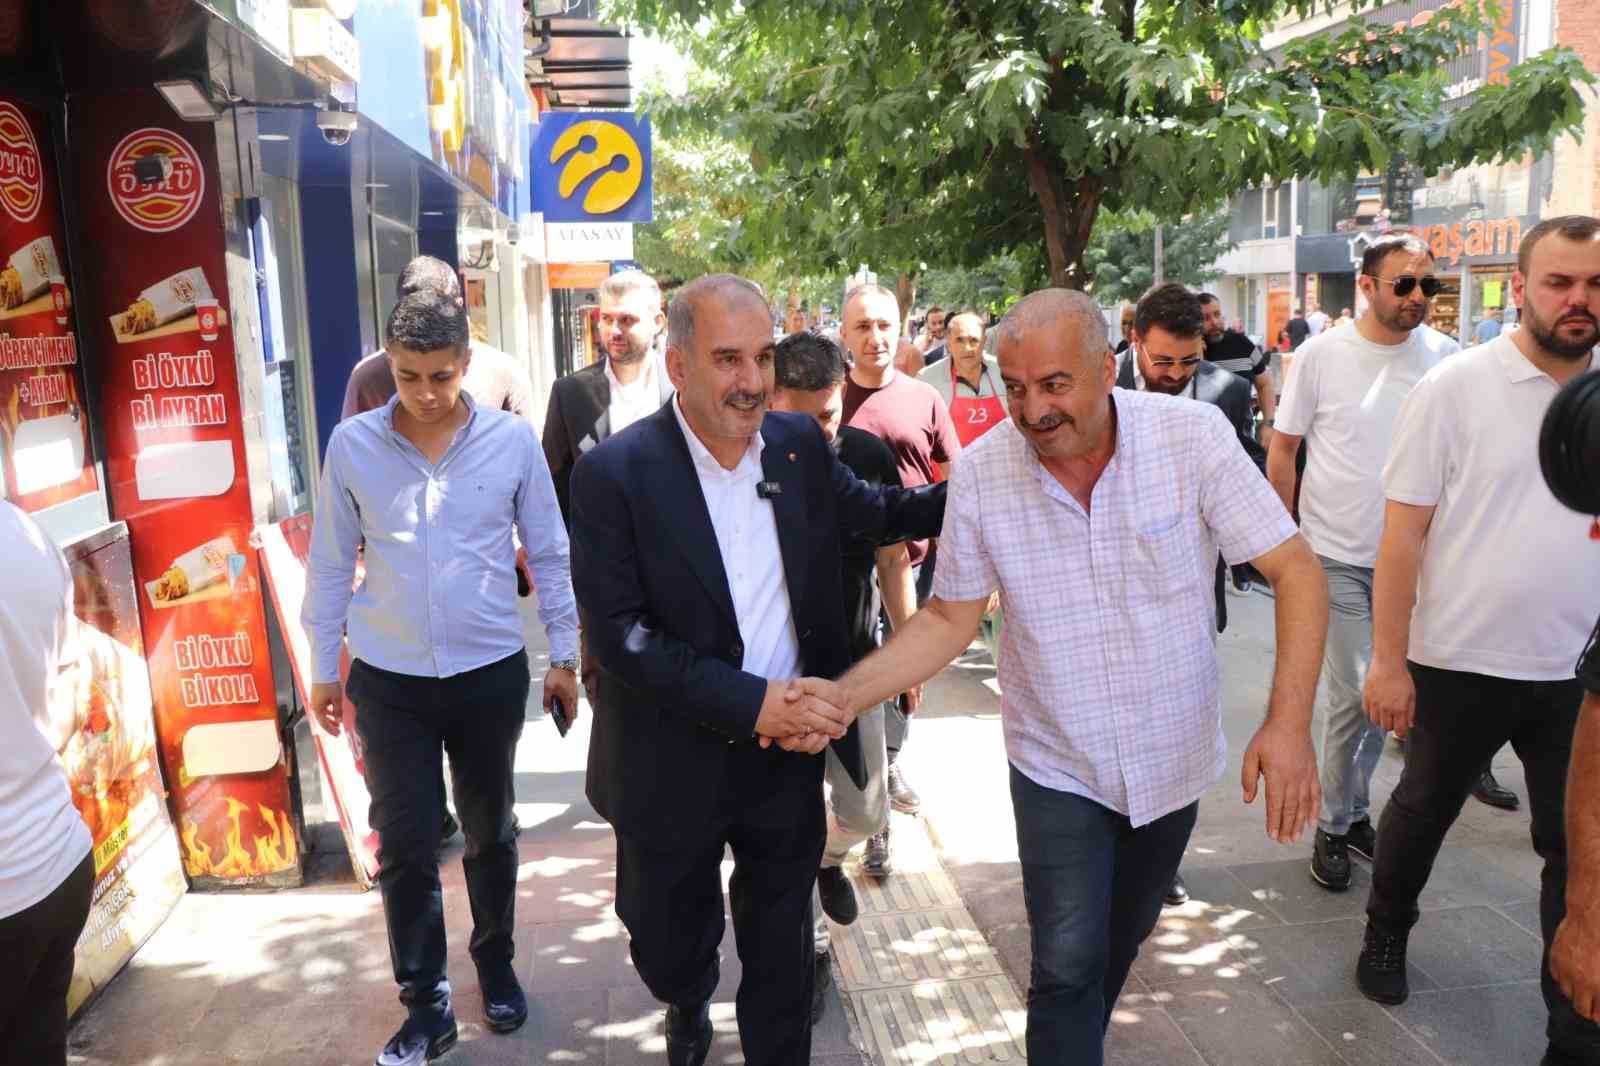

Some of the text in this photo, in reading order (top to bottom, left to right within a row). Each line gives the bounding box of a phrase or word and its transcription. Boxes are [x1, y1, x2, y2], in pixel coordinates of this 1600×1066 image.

[133, 350, 214, 390] Bİ ÖYKÜ
[160, 394, 226, 427] AYRAN
[967, 407, 988, 424] 23
[174, 632, 253, 671] Bİ ÖYKÜ
[205, 674, 259, 705] KOLA
